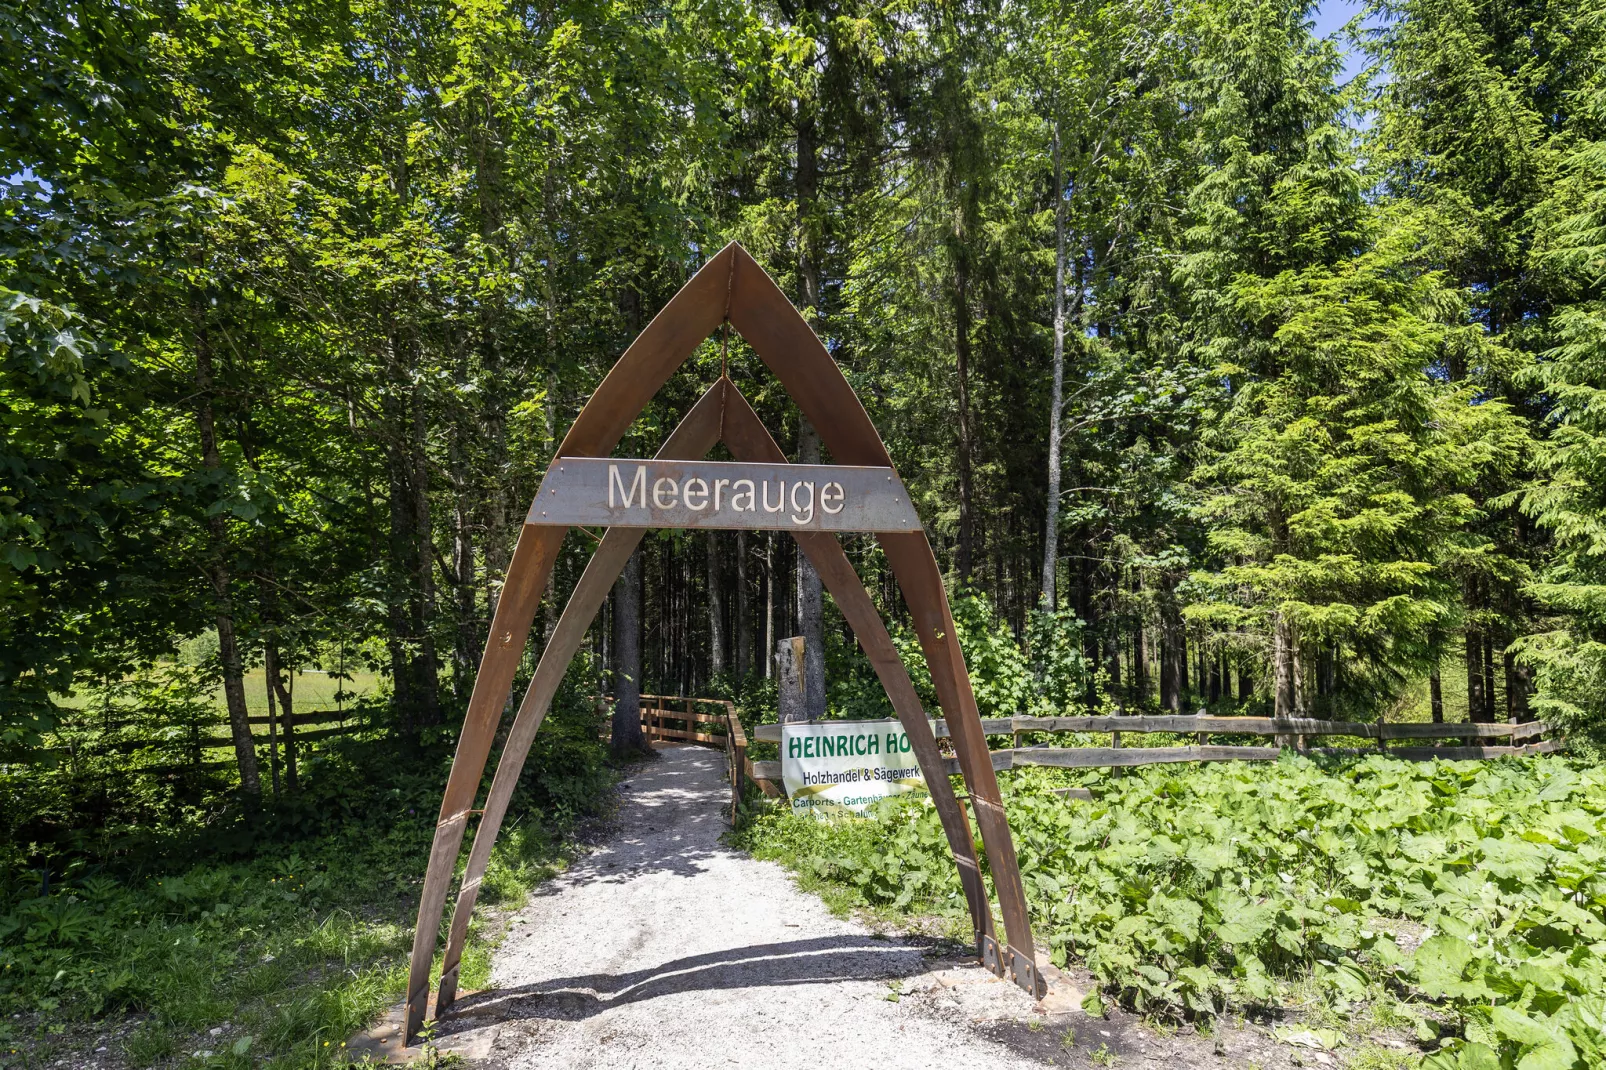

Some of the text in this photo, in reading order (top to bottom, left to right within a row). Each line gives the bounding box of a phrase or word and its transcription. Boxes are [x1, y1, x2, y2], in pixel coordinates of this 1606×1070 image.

[608, 464, 846, 525] Meerauge
[788, 732, 912, 759] HEINRICH HO
[803, 765, 921, 786] Holzhandel & Sägewerk
[793, 797, 835, 809] Carports
[837, 809, 879, 819] Schalun
